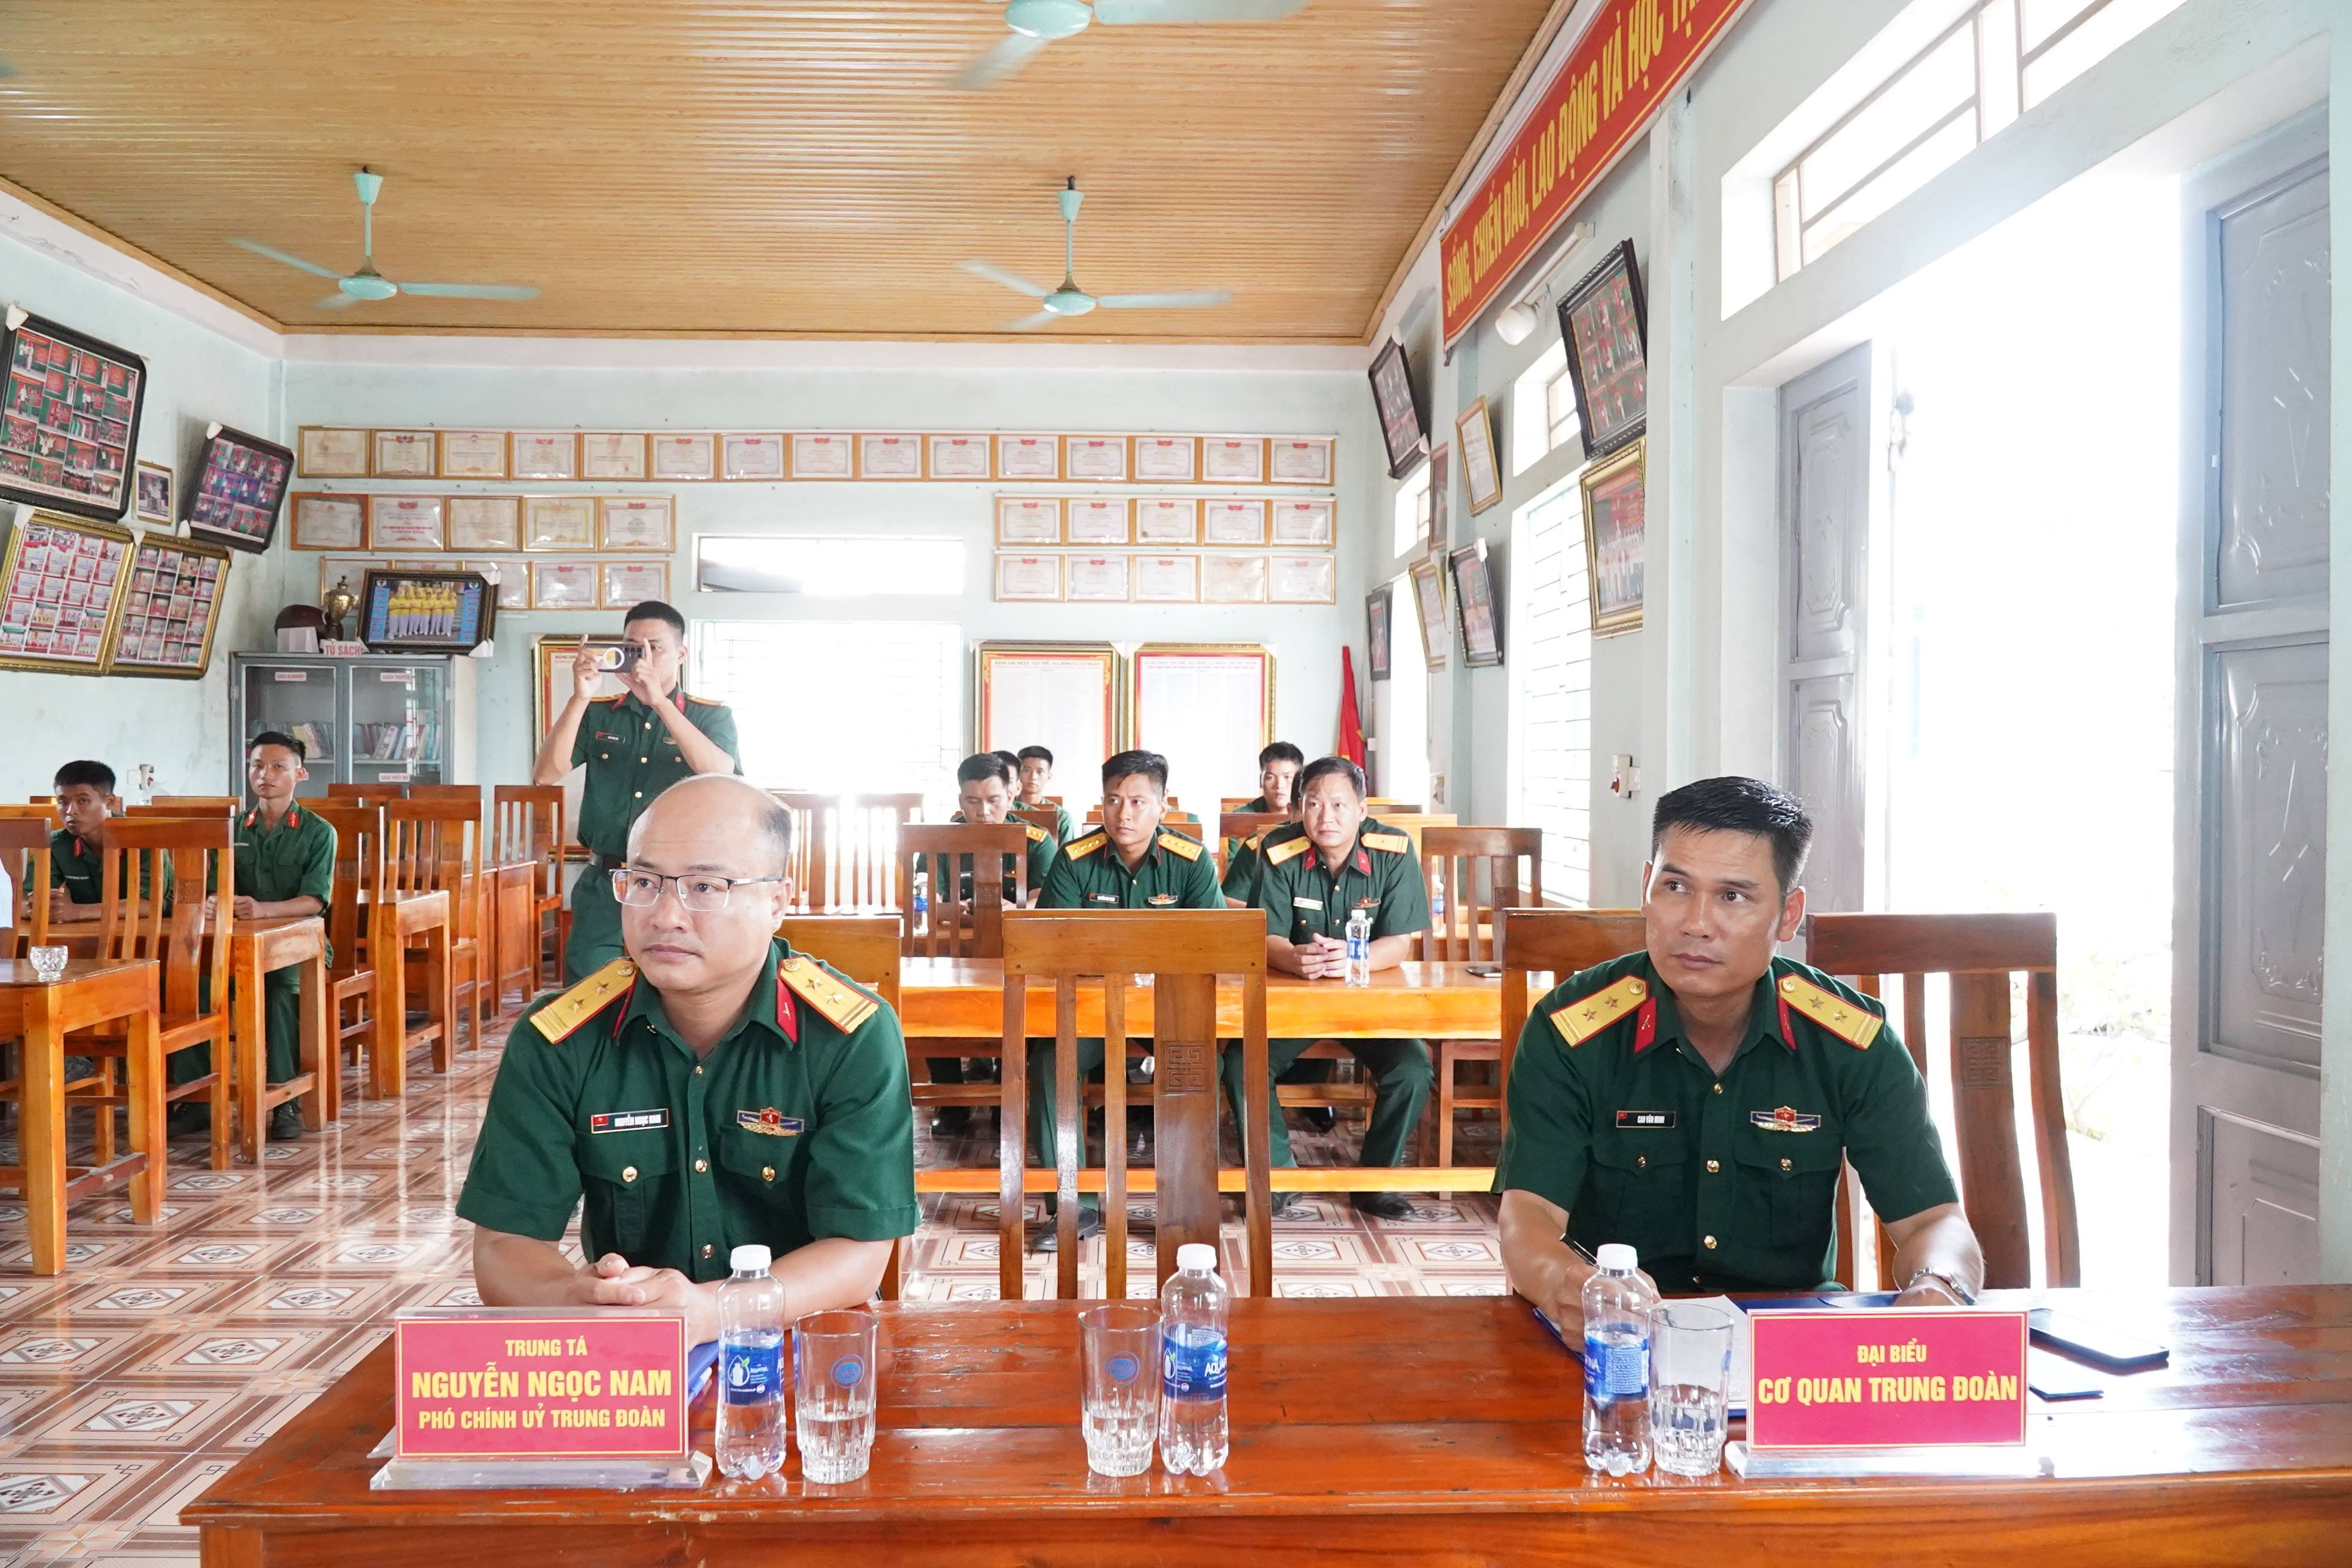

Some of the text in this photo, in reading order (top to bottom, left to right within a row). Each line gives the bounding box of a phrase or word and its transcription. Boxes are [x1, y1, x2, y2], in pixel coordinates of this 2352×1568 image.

[1473, 179, 1502, 284] CHIẾN
[1532, 120, 1555, 211] LAO
[1558, 60, 1598, 180] ĐỘNG
[1603, 10, 1623, 120] VÀ
[1628, 0, 1664, 91] HỌC
[505, 1335, 587, 1356] TRUNG TÁ
[1857, 1337, 1927, 1367] ĐẠI BIỂU
[412, 1361, 672, 1403] NGUYỄN NGỌC NAM
[1758, 1370, 2017, 1406] CƠ QUAN TRUNG ĐOÀN
[419, 1402, 666, 1429] PHÓ CHÍNH UỶ TRUNG ĐOÀN
